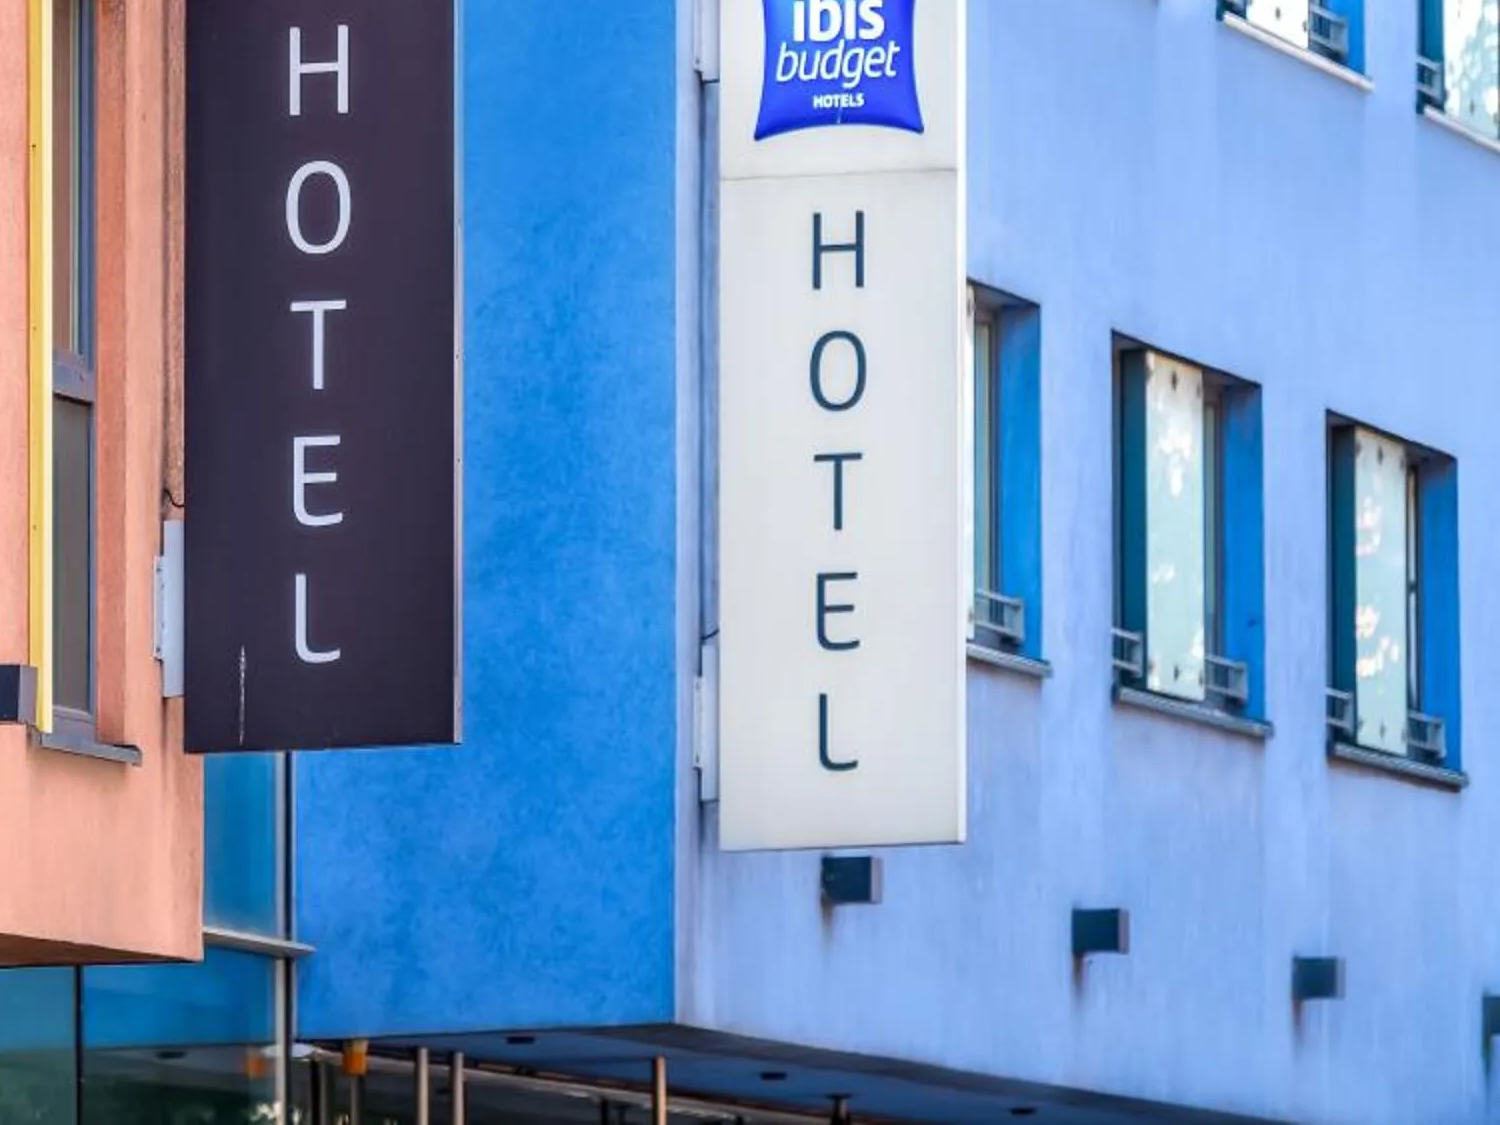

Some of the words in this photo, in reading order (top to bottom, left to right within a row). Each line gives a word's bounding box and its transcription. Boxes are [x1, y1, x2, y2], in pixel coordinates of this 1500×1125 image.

[775, 38, 901, 89] budget
[813, 92, 865, 108] HOTELS
[285, 24, 351, 663] HOTEL
[809, 210, 867, 772] HOTEL
